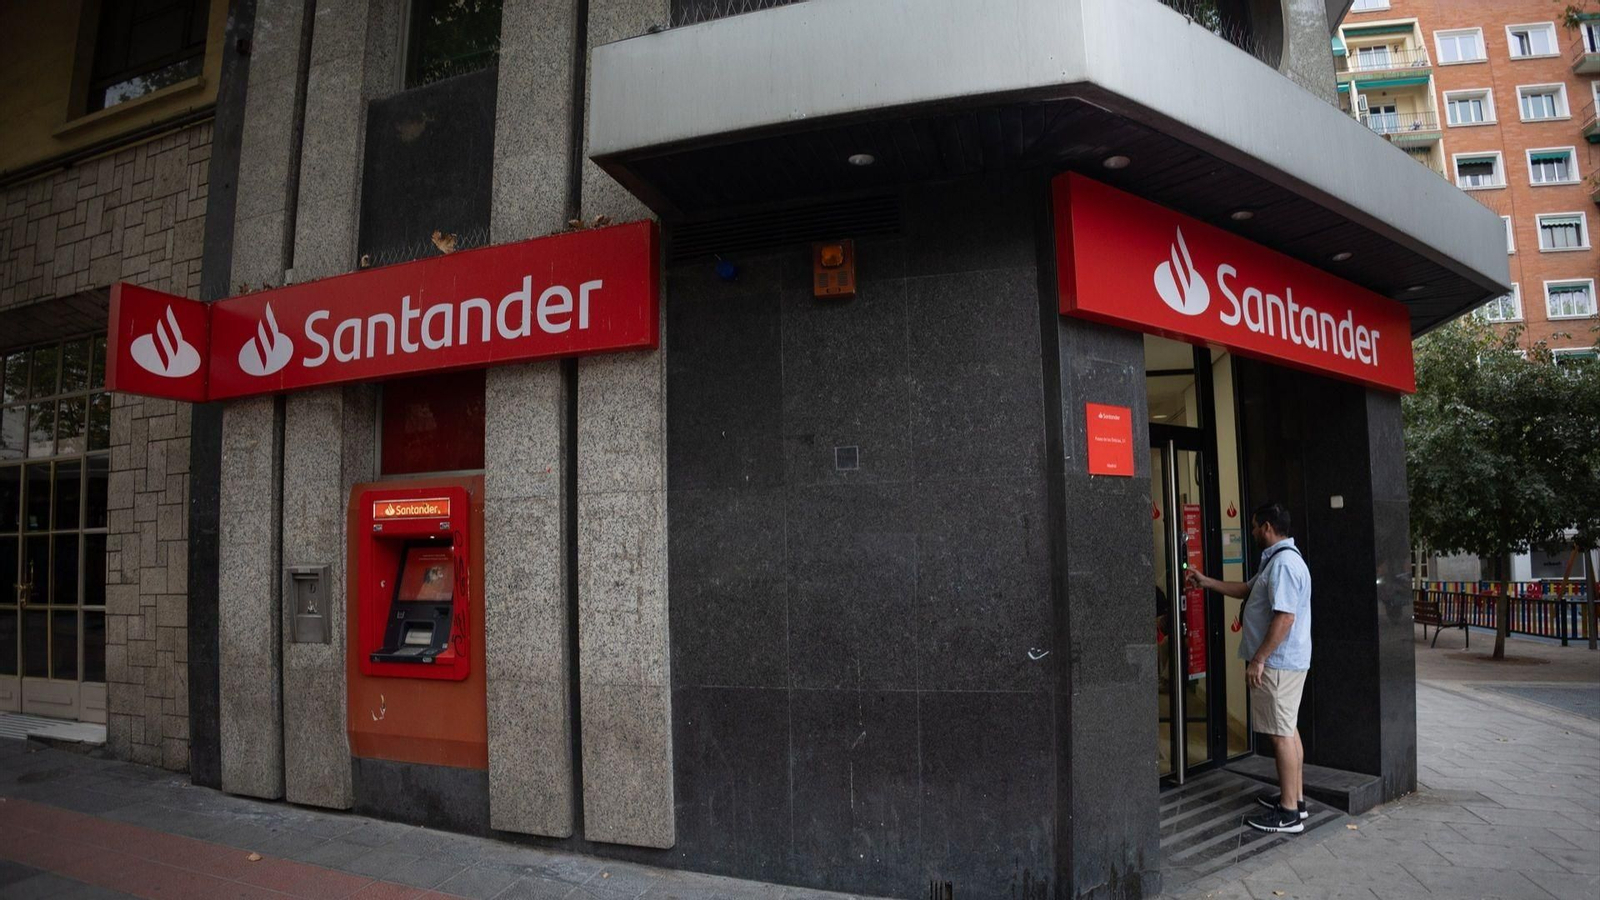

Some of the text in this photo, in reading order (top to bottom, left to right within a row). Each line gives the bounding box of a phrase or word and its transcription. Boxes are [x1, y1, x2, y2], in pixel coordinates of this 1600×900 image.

[303, 275, 602, 367] Santander
[1217, 263, 1380, 366] Santander
[396, 503, 438, 515] Santander
